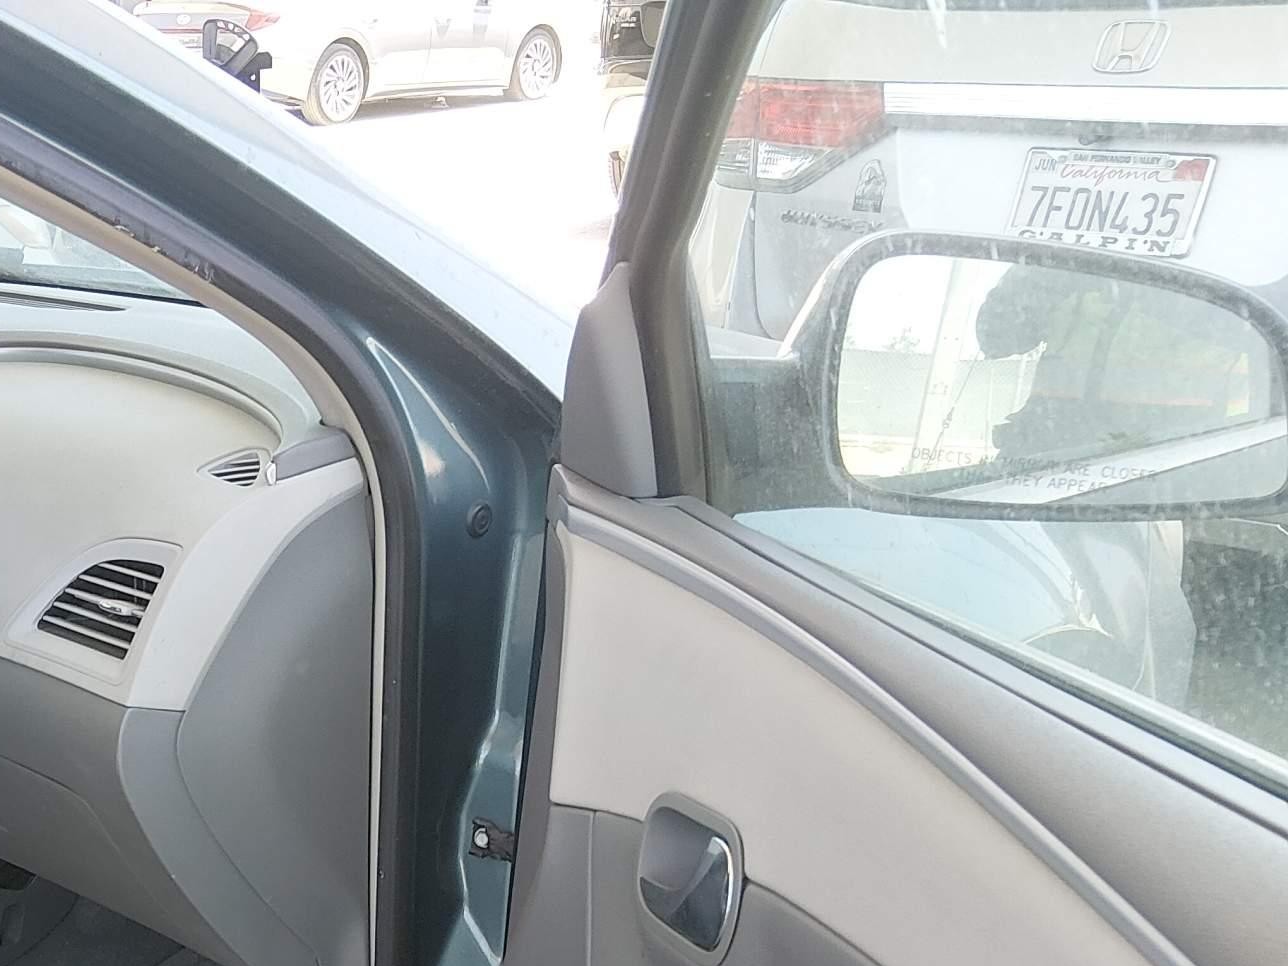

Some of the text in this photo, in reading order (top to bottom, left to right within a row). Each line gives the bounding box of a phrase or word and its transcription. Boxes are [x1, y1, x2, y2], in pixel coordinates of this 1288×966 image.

[1034, 158, 1057, 172] JUN
[1060, 163, 1170, 187] California
[911, 447, 972, 465] OBJECTS
